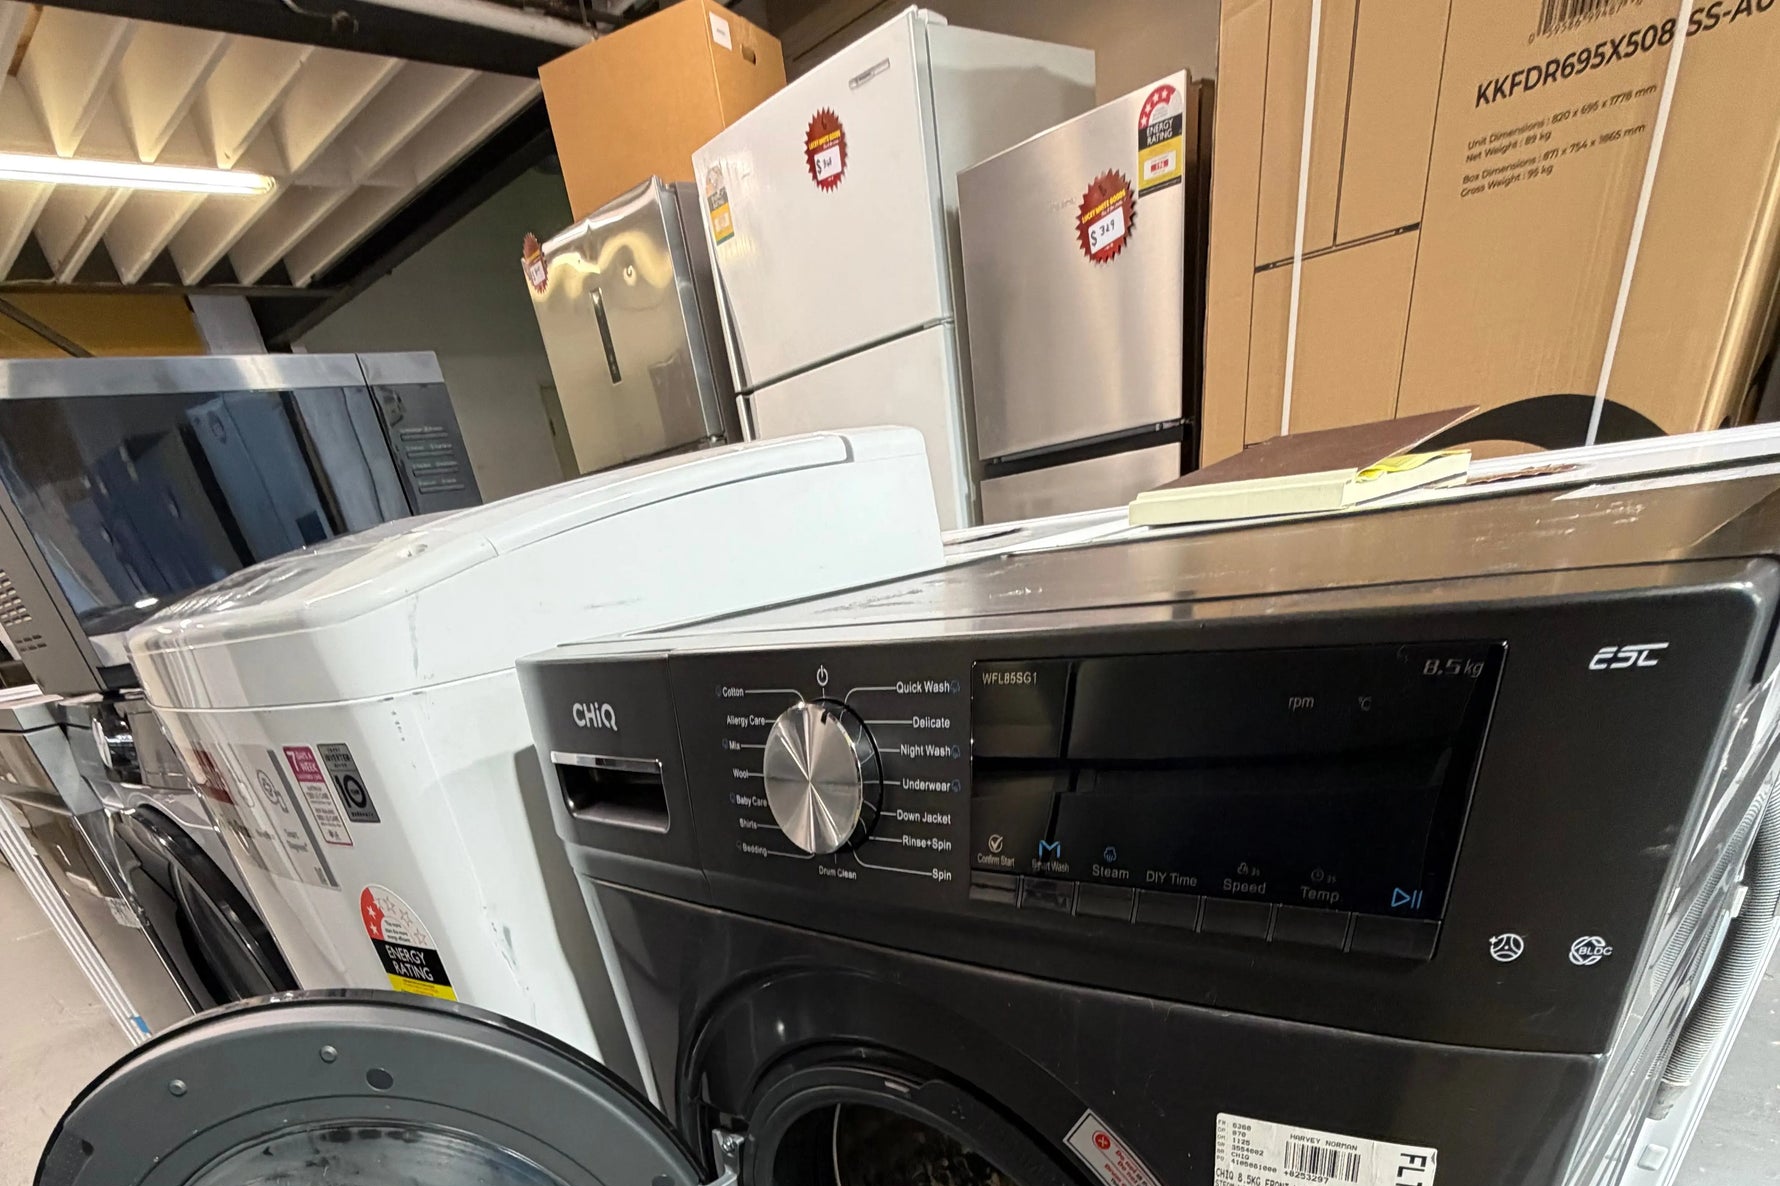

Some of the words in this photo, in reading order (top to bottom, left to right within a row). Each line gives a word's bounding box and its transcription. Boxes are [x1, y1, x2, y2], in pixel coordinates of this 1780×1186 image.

[1468, 136, 1487, 150] Unit
[1490, 118, 1545, 142] Dimensions
[1551, 110, 1570, 124] 820
[1580, 101, 1599, 115] 695
[1634, 85, 1657, 99] mm
[1147, 118, 1174, 137] ENERGY
[1147, 129, 1173, 146] RATING
[1465, 152, 1482, 163] Net
[1484, 141, 1517, 158] Weight
[1538, 130, 1552, 144] kg
[1462, 173, 1479, 185] Box
[1481, 155, 1536, 180] Dimensions
[1623, 124, 1646, 137] mm
[1487, 172, 1520, 190] Weight
[1540, 163, 1554, 177] kg
[1081, 209, 1095, 224] LUCKY
[982, 671, 1037, 685] WFL85SG1
[722, 687, 744, 697] Cotton
[896, 681, 922, 694] Quick
[923, 680, 950, 692] Wash
[1288, 696, 1315, 712] rpm
[726, 715, 748, 728] Allergy
[749, 715, 765, 726] Care
[912, 716, 950, 728] Delicate
[729, 740, 741, 750] Mix
[900, 744, 923, 758] Night
[925, 744, 951, 757] Wash
[733, 768, 748, 779] Wool
[902, 779, 951, 791] Underwear
[736, 794, 751, 807] Baby
[752, 796, 768, 807] Care
[896, 809, 921, 822] Down
[922, 812, 951, 825] Jacket
[742, 842, 768, 857] Bedding
[902, 835, 952, 850] Rinse+Spin
[977, 852, 1000, 865] Confirm
[1000, 855, 1015, 867] Start
[818, 866, 837, 877] Drum
[837, 867, 857, 880] Clean
[932, 868, 952, 881] Spin
[1051, 862, 1070, 873] Wash
[1092, 864, 1130, 880] Steam
[1146, 870, 1166, 884] DIY
[1170, 872, 1197, 887] Time
[1223, 878, 1266, 895] Speed
[1301, 885, 1340, 903] Temp
[385, 945, 427, 965] ENERGY
[1579, 946, 1613, 956] BLDC
[392, 961, 434, 981] RATING
[1290, 1133, 1321, 1144] HARVEY
[1325, 1140, 1358, 1151] NORMAN
[1215, 1168, 1234, 1180] CHIQ
[1237, 1173, 1261, 1186] 8.5KG
